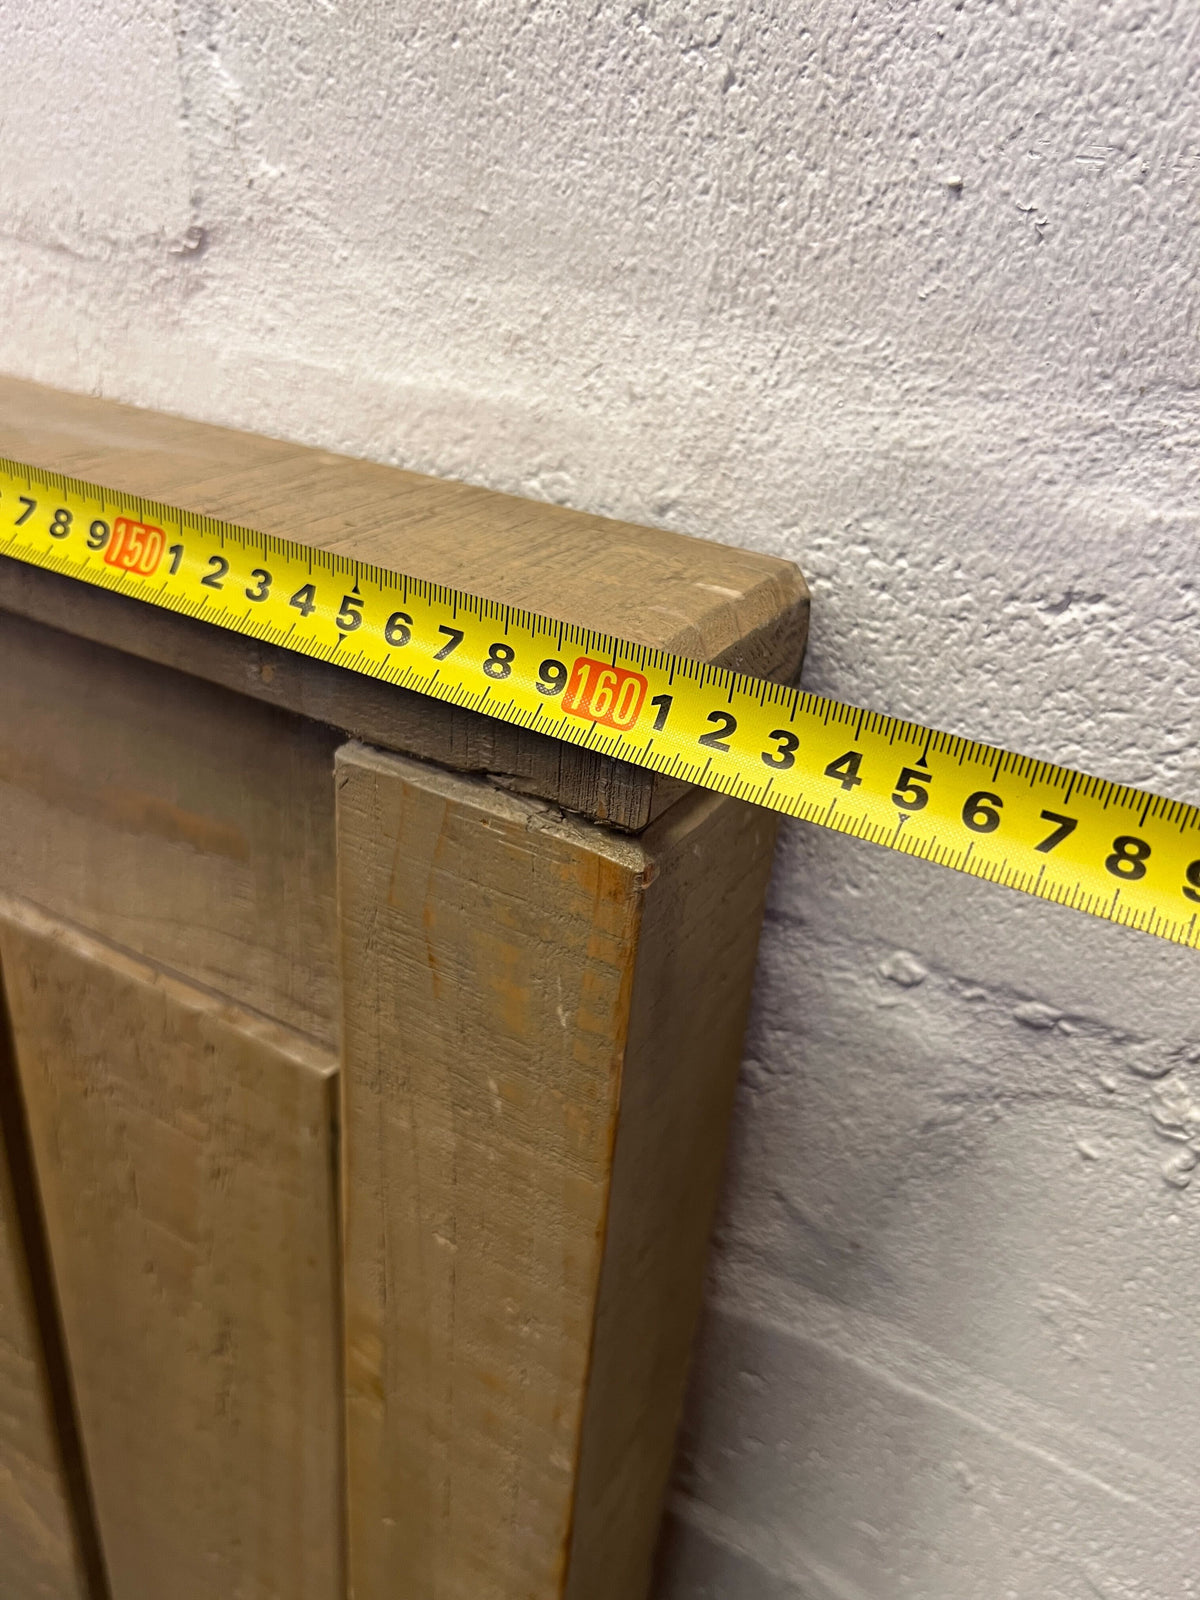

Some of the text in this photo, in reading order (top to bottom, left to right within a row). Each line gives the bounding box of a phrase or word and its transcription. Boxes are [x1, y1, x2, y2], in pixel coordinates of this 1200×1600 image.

[14, 496, 37, 526] 7
[49, 509, 73, 539] 8
[86, 520, 110, 550] 9
[110, 523, 162, 573] 150
[169, 544, 184, 575] 1
[201, 555, 229, 590] 2
[245, 568, 273, 602] 3
[289, 583, 316, 617] 4
[336, 595, 364, 631] 5
[385, 611, 413, 647] 6
[433, 625, 465, 661] 7
[482, 642, 516, 680] 8
[535, 658, 568, 696] 9
[570, 664, 641, 725] 160
[650, 694, 673, 732] 1
[697, 710, 738, 753] 2
[761, 729, 800, 770] 3
[823, 750, 863, 791] 4
[891, 766, 933, 811] 5
[961, 791, 1004, 833] 6
[1033, 809, 1078, 854] 7
[1104, 835, 1152, 881] 8
